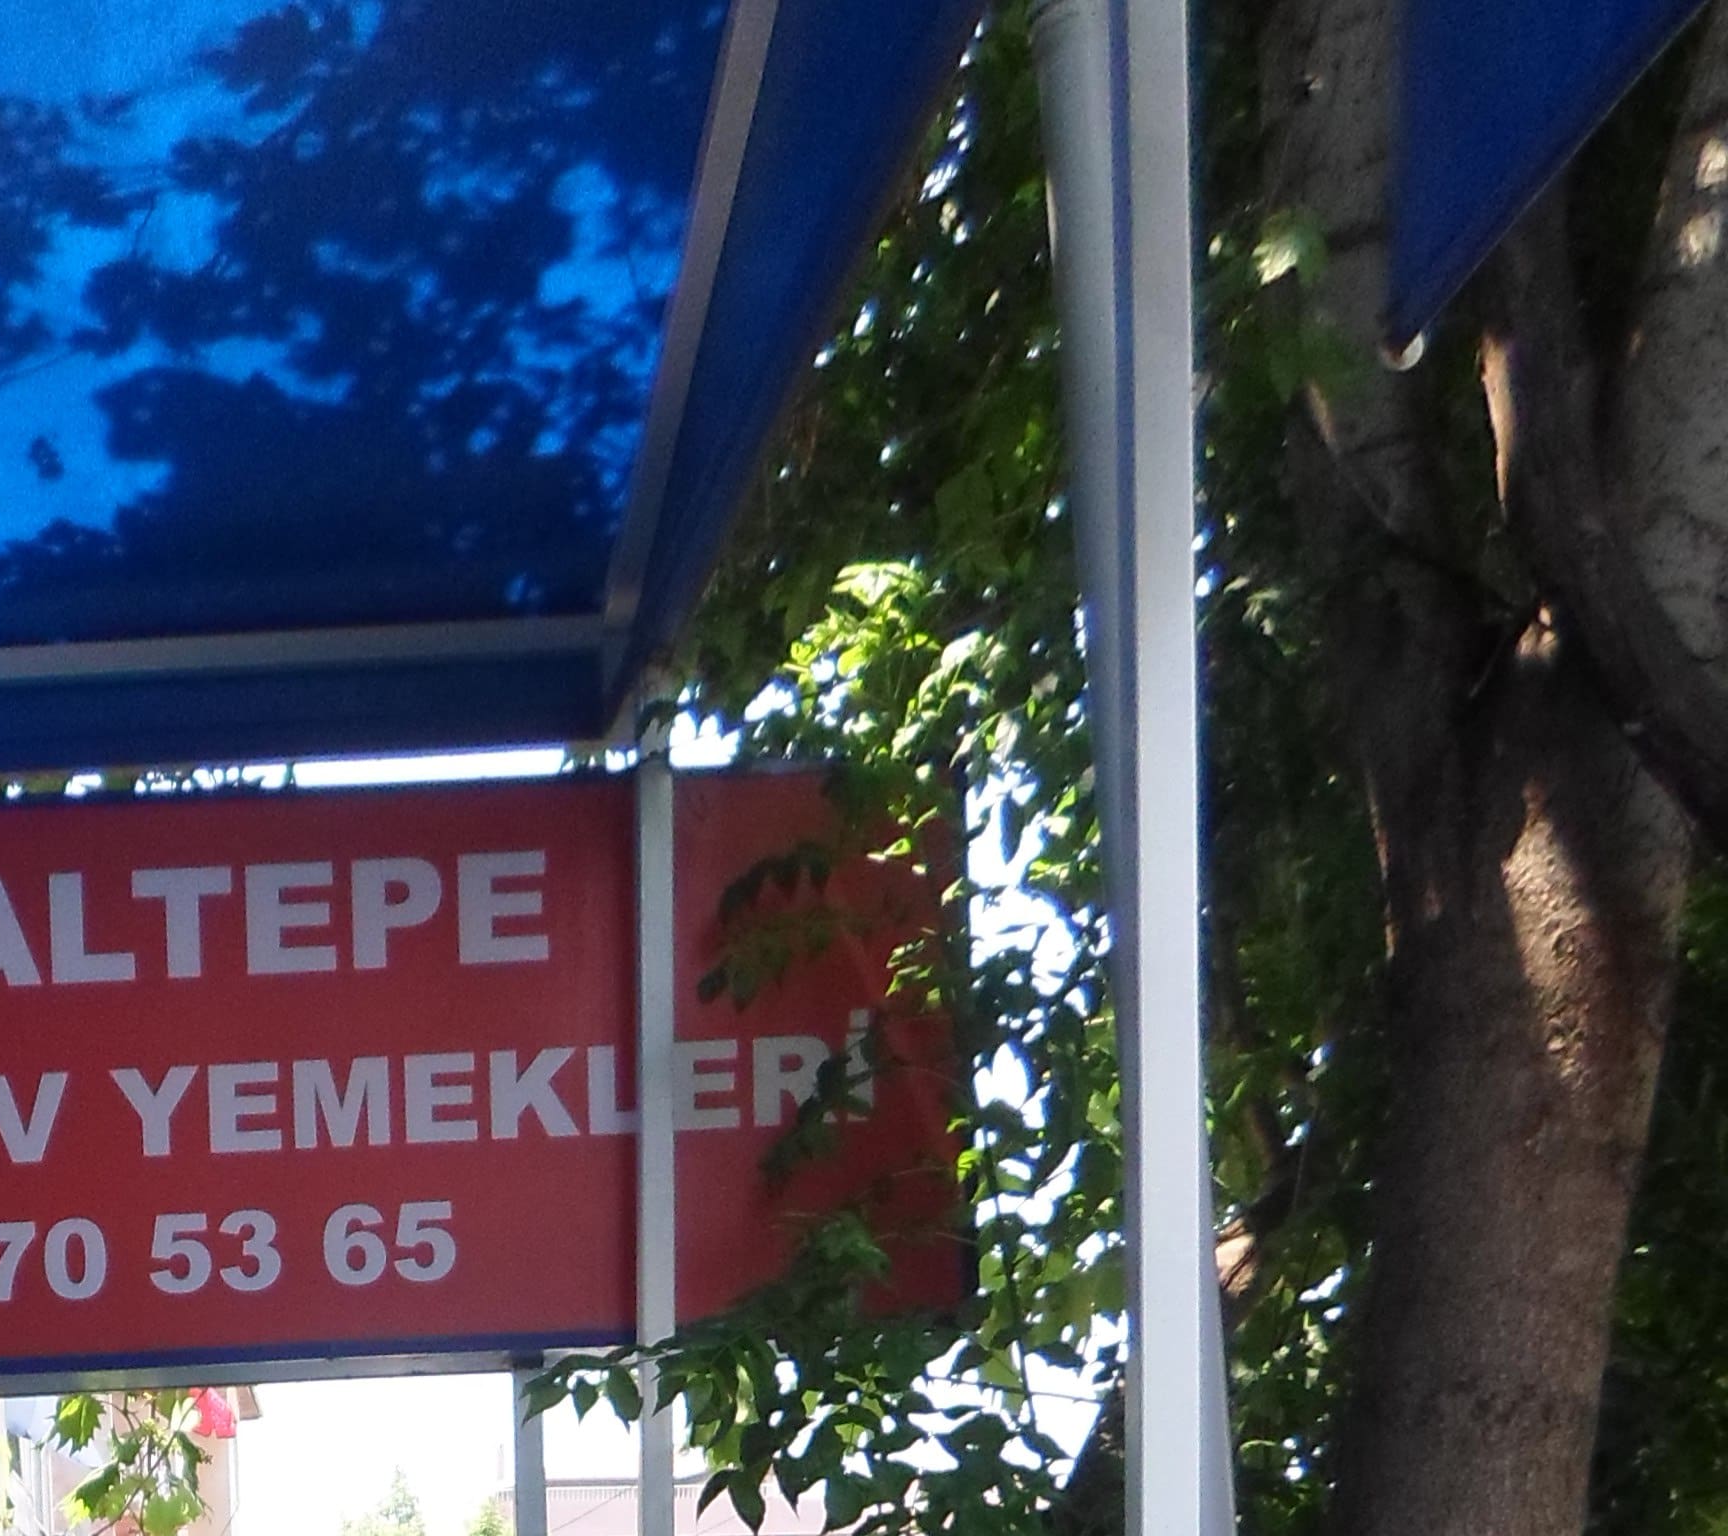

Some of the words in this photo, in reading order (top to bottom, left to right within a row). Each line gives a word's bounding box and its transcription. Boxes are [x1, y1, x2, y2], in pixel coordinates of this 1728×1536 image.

[109, 1008, 876, 1159] YEMEKLERİ
[148, 1208, 282, 1294] 53
[322, 1200, 457, 1286] 65
